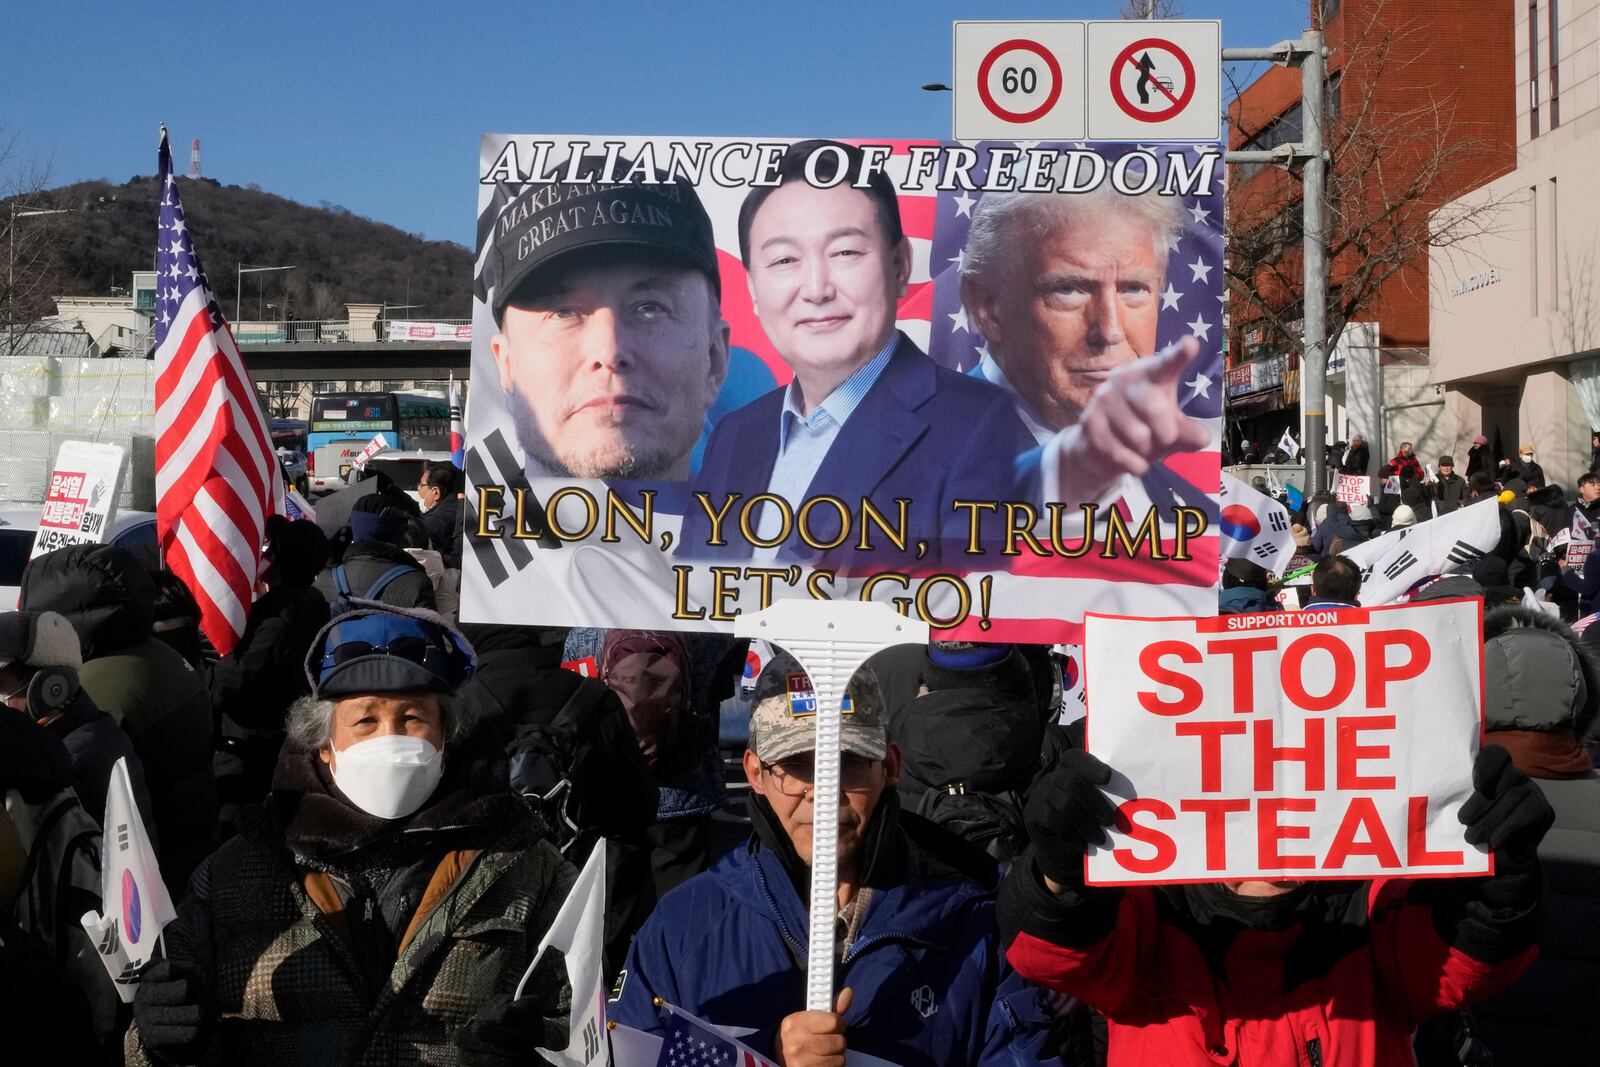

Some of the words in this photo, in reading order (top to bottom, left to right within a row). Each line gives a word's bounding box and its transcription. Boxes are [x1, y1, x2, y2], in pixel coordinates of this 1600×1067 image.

[1002, 67, 1037, 94] 60
[480, 141, 790, 187] ALLIANCE
[803, 144, 892, 190] OF
[899, 145, 1223, 197] FREEDOM
[500, 186, 560, 237] MAKE
[517, 206, 585, 260] GREAT
[592, 199, 673, 227] AGAIN
[50, 475, 82, 496] 윤석열
[1336, 493, 1367, 503] STEAL
[1339, 476, 1363, 486] STOP
[1341, 485, 1360, 494] THE
[45, 500, 84, 525] 대통령과
[82, 512, 103, 534] 함께
[474, 485, 675, 551] ELON,
[693, 492, 929, 558] YOON,
[952, 499, 1210, 561] TRUMP
[1227, 614, 1295, 630] SUPPORT
[1298, 611, 1338, 626] YOON
[1137, 628, 1431, 716] STOP
[1175, 715, 1396, 793] THE
[1112, 796, 1464, 874] STEAL
